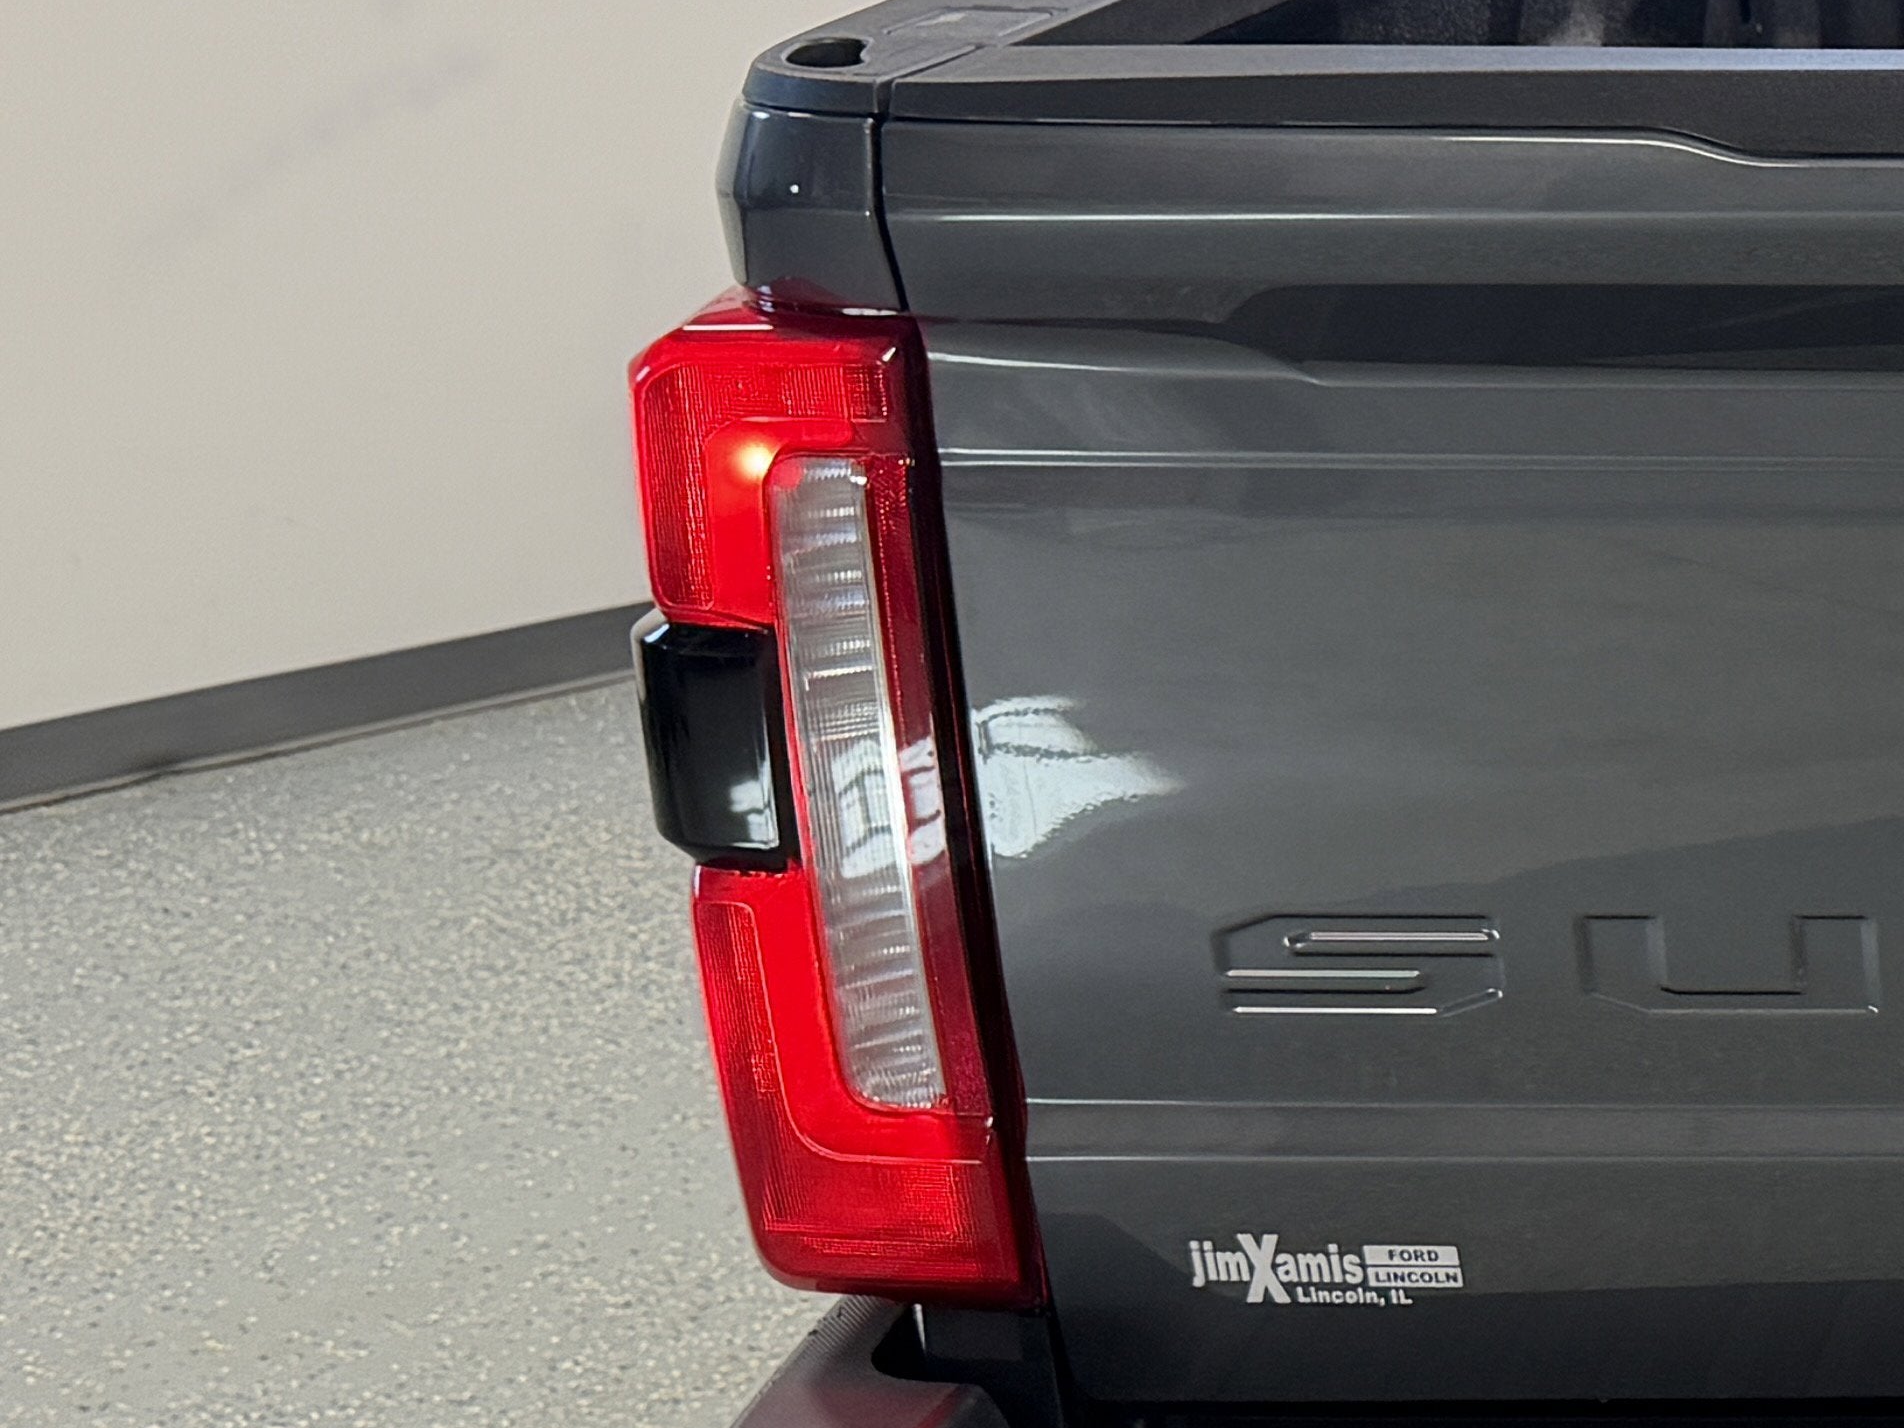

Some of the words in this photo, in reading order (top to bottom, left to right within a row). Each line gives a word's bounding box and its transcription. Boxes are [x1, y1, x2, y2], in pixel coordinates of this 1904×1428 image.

[1387, 1248, 1440, 1262] FORD
[1374, 1271, 1460, 1284] LINCOLN
[1296, 1286, 1386, 1307] Lincoln,
[1391, 1288, 1414, 1305] IL
